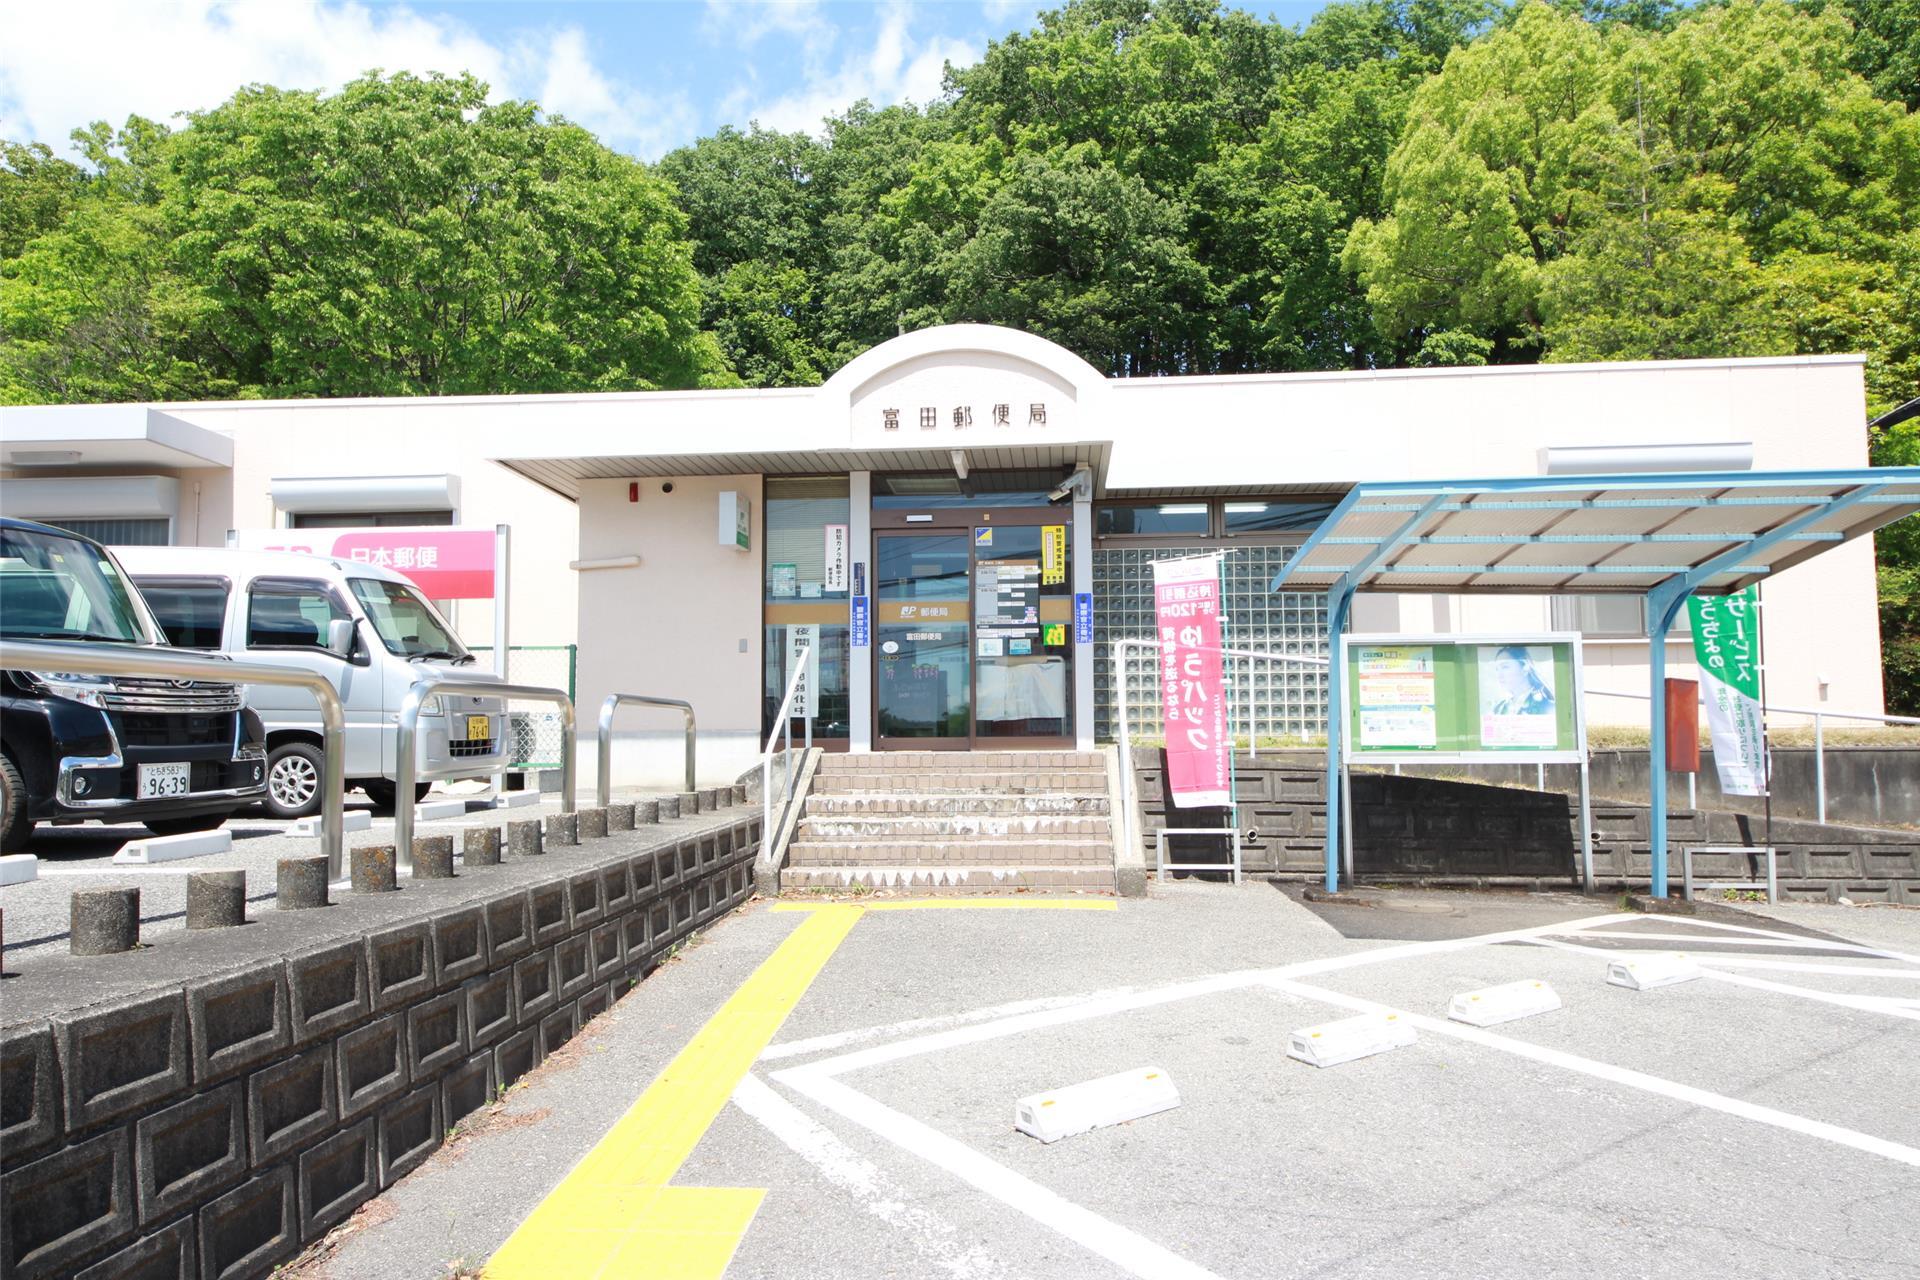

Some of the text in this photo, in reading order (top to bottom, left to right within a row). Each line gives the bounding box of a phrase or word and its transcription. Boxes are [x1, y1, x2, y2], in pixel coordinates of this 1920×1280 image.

[882, 403, 1047, 429] 富田郵便局
[351, 546, 438, 568] 日本郵便
[920, 607, 948, 617] 郵便局
[149, 776, 187, 795] 96-39
